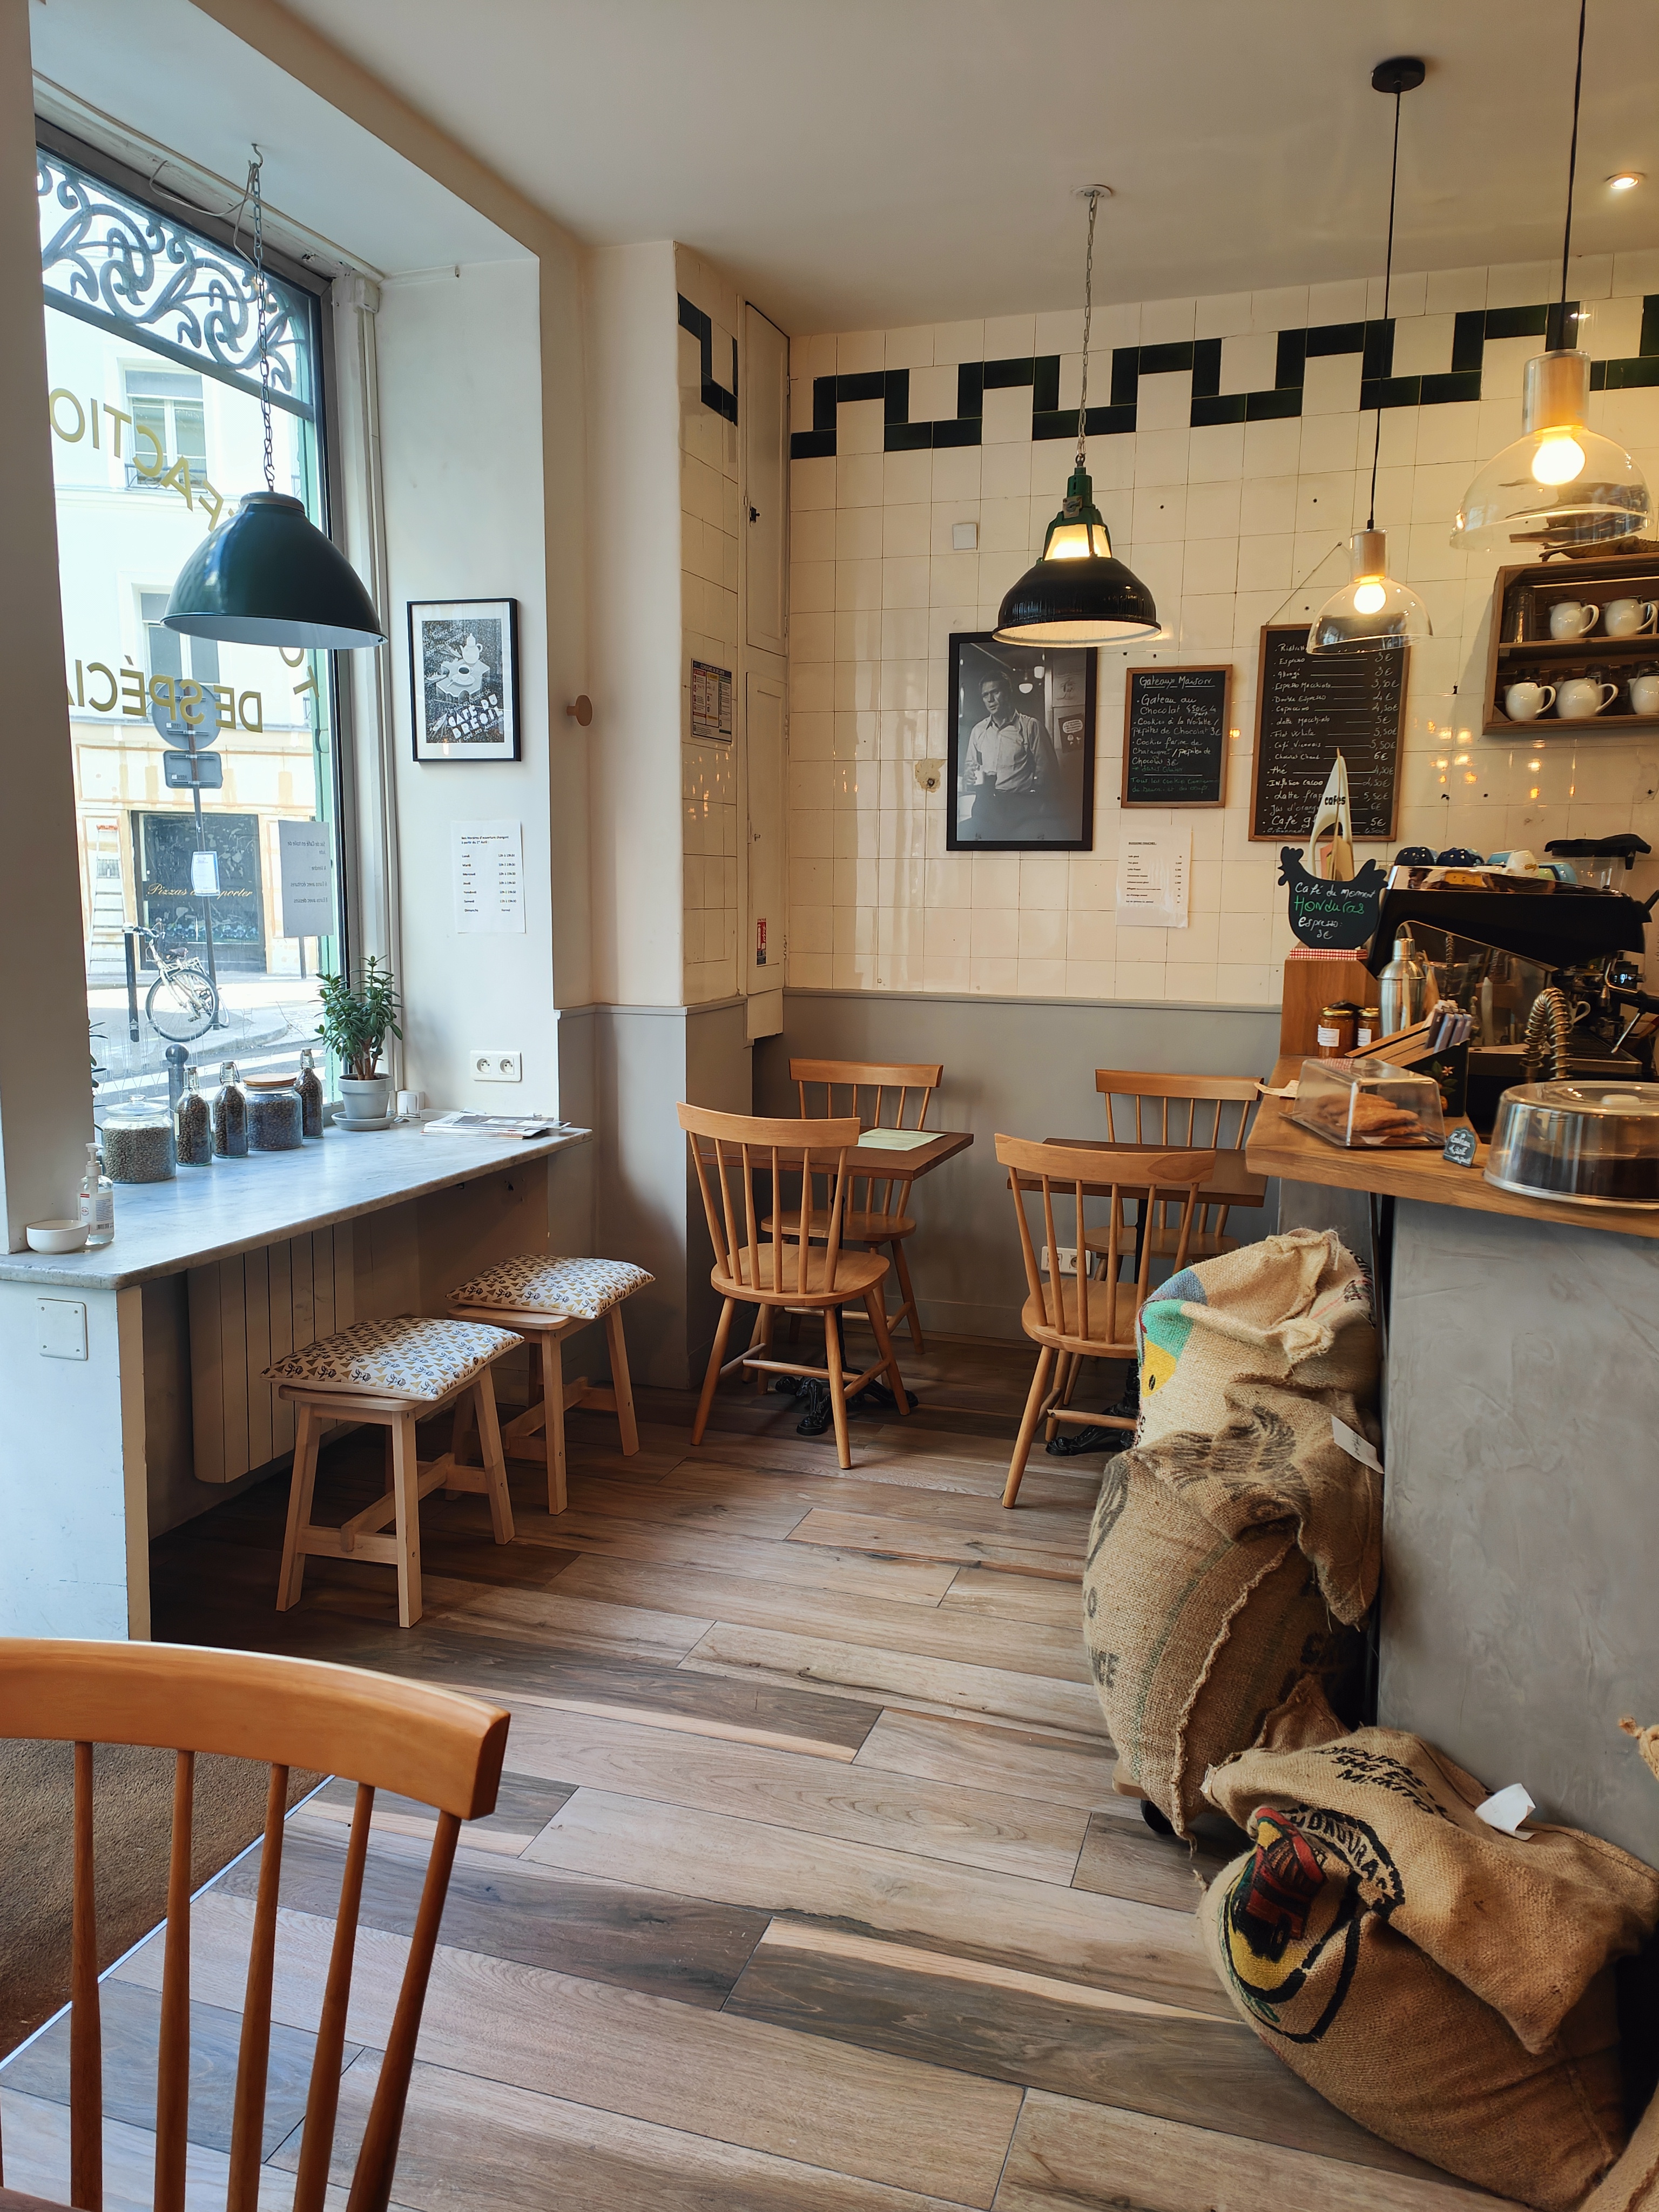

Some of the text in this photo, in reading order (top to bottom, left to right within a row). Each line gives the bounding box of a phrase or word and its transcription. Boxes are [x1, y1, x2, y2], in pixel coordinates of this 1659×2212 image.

[1278, 643, 1307, 652] Ristrett
[448, 693, 498, 727] CAFÉ DU
[1140, 704, 1181, 715] Chocolat
[452, 706, 503, 739] BRÉSIL
[463, 732, 474, 740] CAFÉ
[1274, 740, 1290, 751] Café
[1302, 790, 1323, 803] frap
[1270, 805, 1283, 816] Jus
[1272, 813, 1298, 830] Café
[1370, 817, 1386, 826] 5€
[147, 883, 253, 900] Pizzas porter
[1294, 882, 1324, 895] Café
[1326, 884, 1337, 896] du
[1318, 1746, 1428, 1788] ONDURAS
